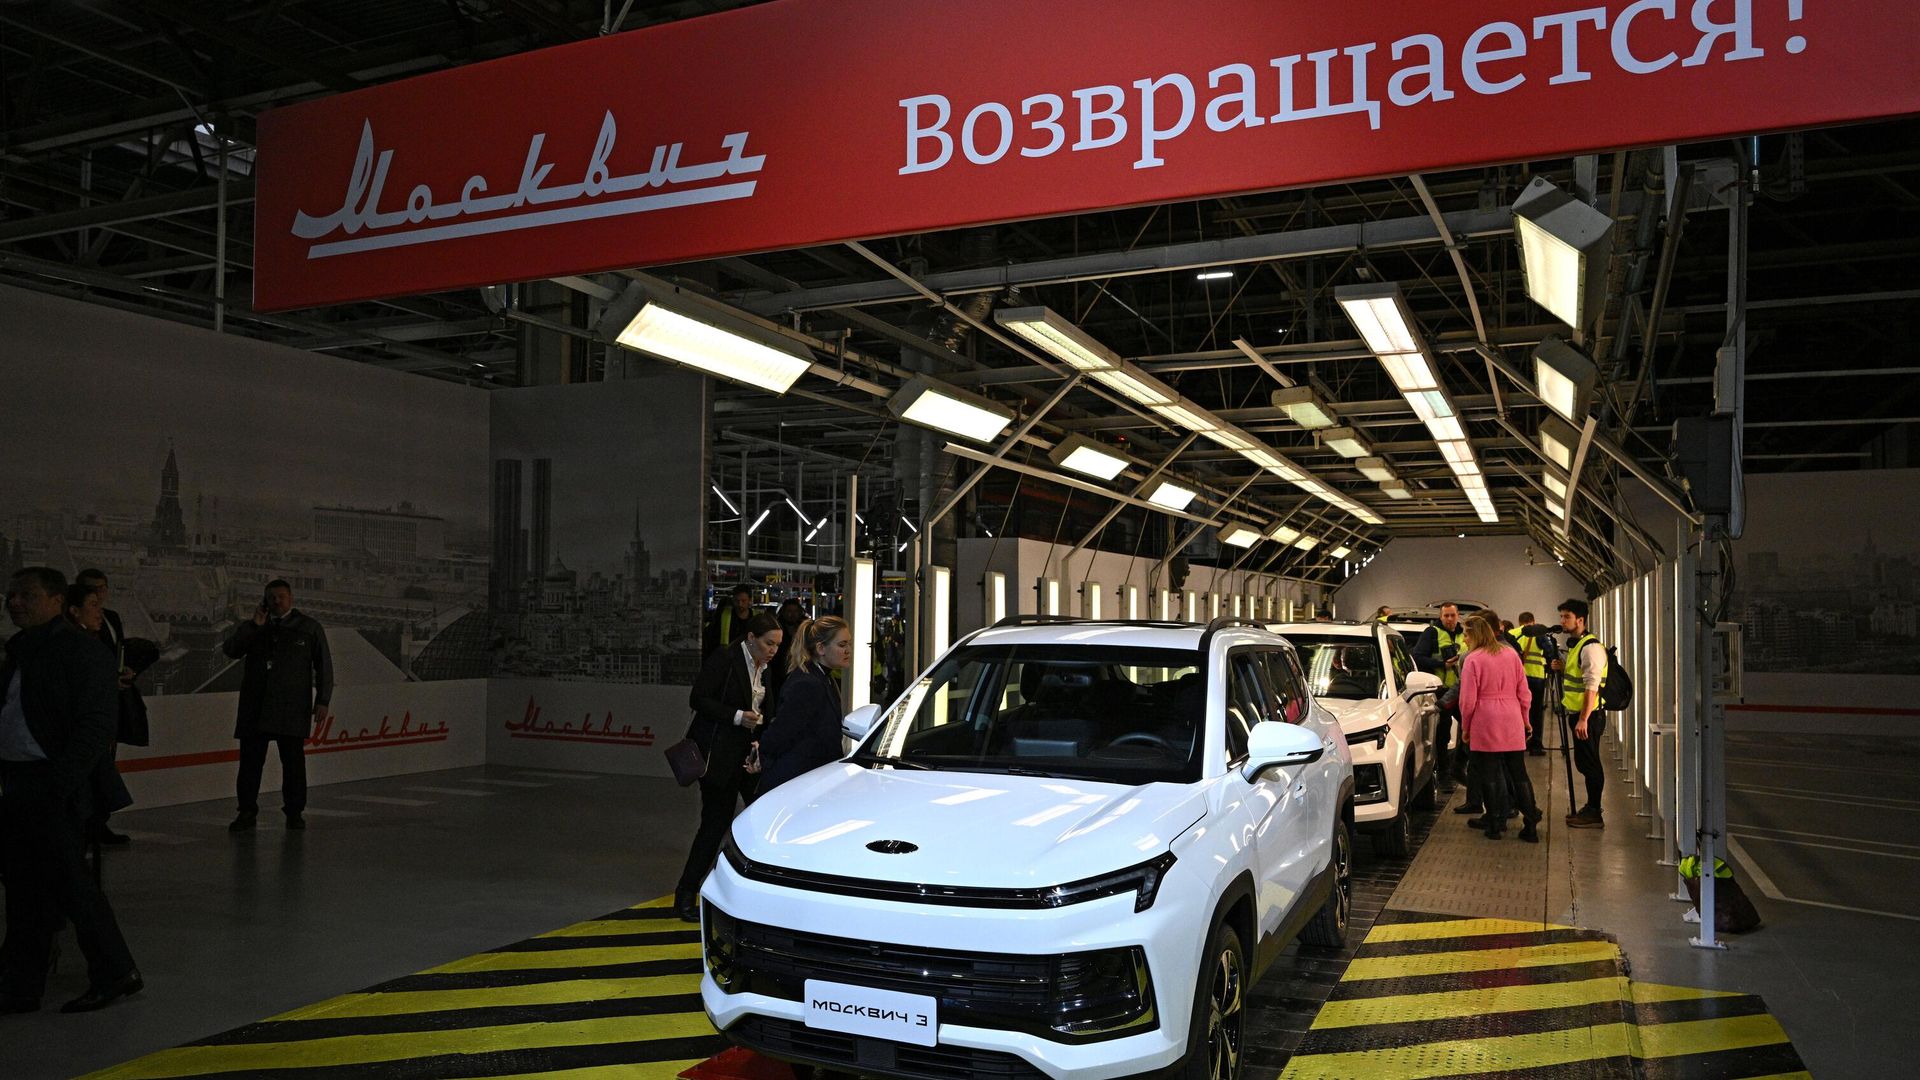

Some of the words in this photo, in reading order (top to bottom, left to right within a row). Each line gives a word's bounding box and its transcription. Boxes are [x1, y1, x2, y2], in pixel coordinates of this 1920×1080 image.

[899, 0, 1807, 172] Возвращается!
[812, 999, 908, 1023] МОСКВИЧ
[915, 1014, 928, 1027] 3
